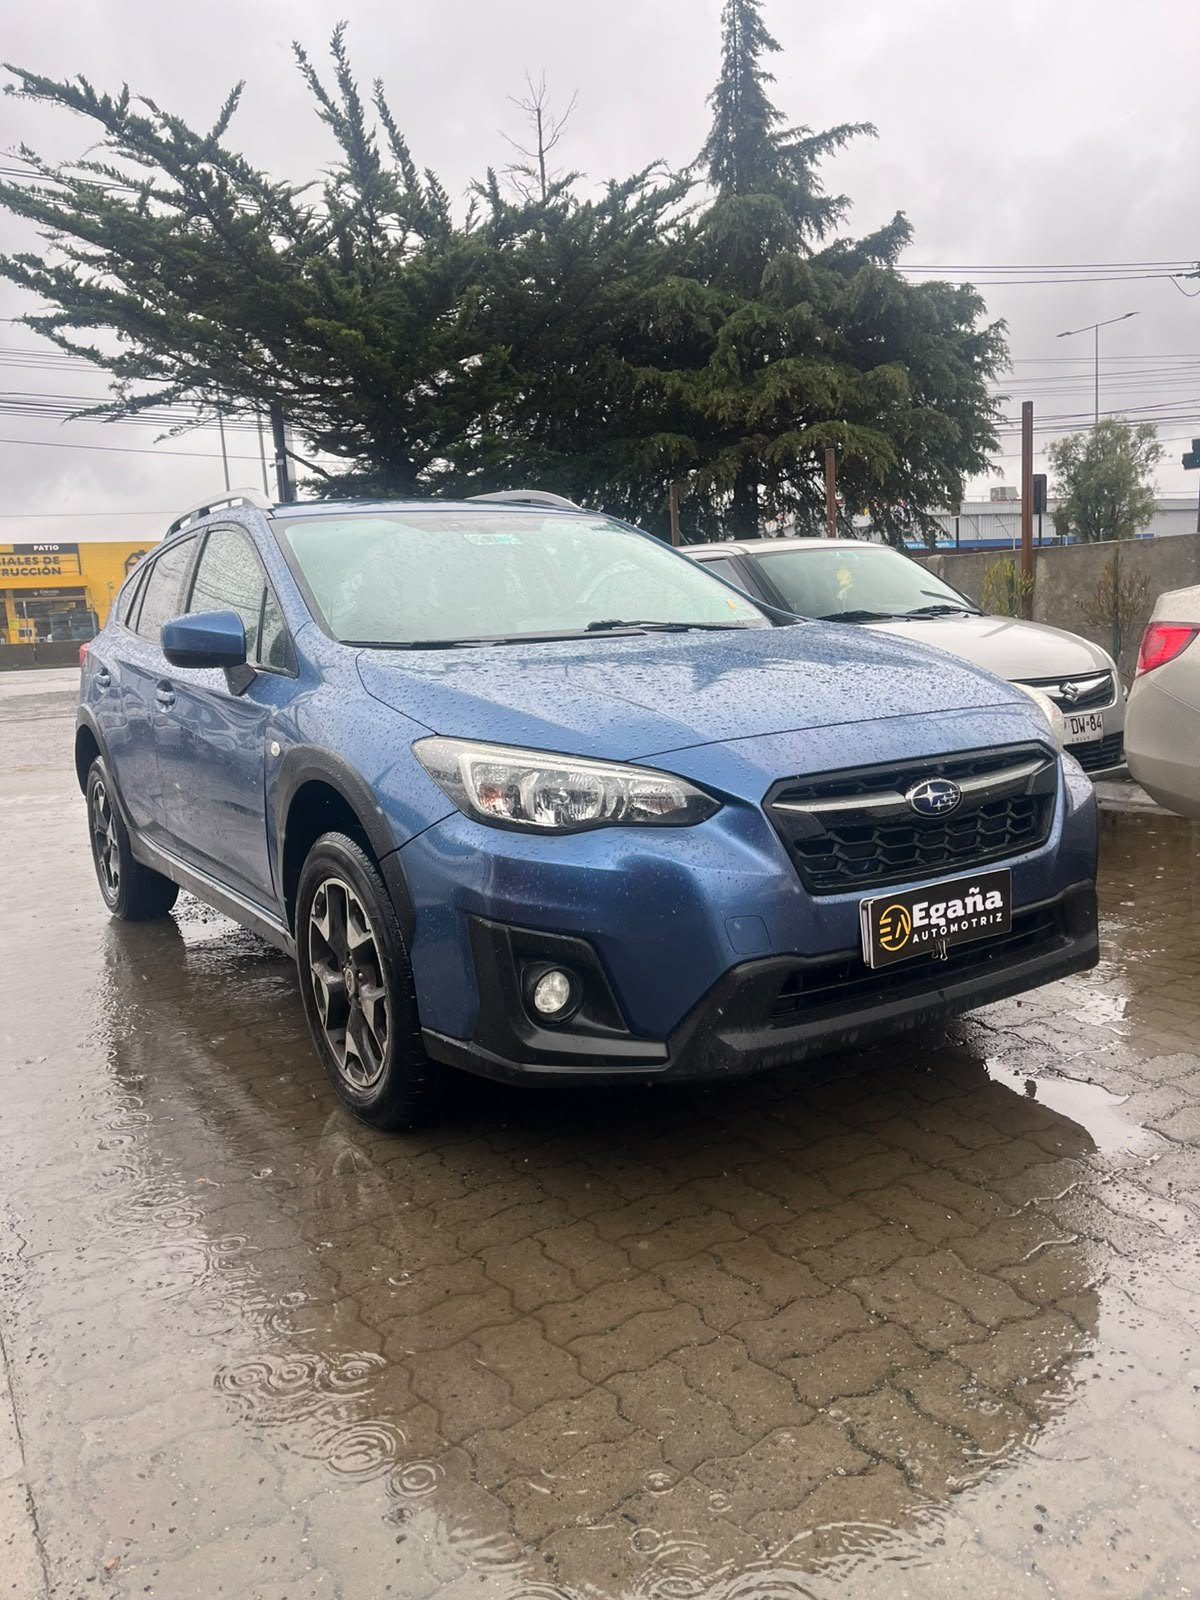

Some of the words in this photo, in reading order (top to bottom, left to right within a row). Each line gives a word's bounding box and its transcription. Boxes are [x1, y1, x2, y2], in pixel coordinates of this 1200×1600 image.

[0, 557, 39, 566] IALES
[43, 556, 60, 565] DE
[1, 565, 61, 576] RUCCIÓN
[912, 887, 1003, 928] Egaña
[912, 912, 1003, 944] AUTOMOTRIZ
